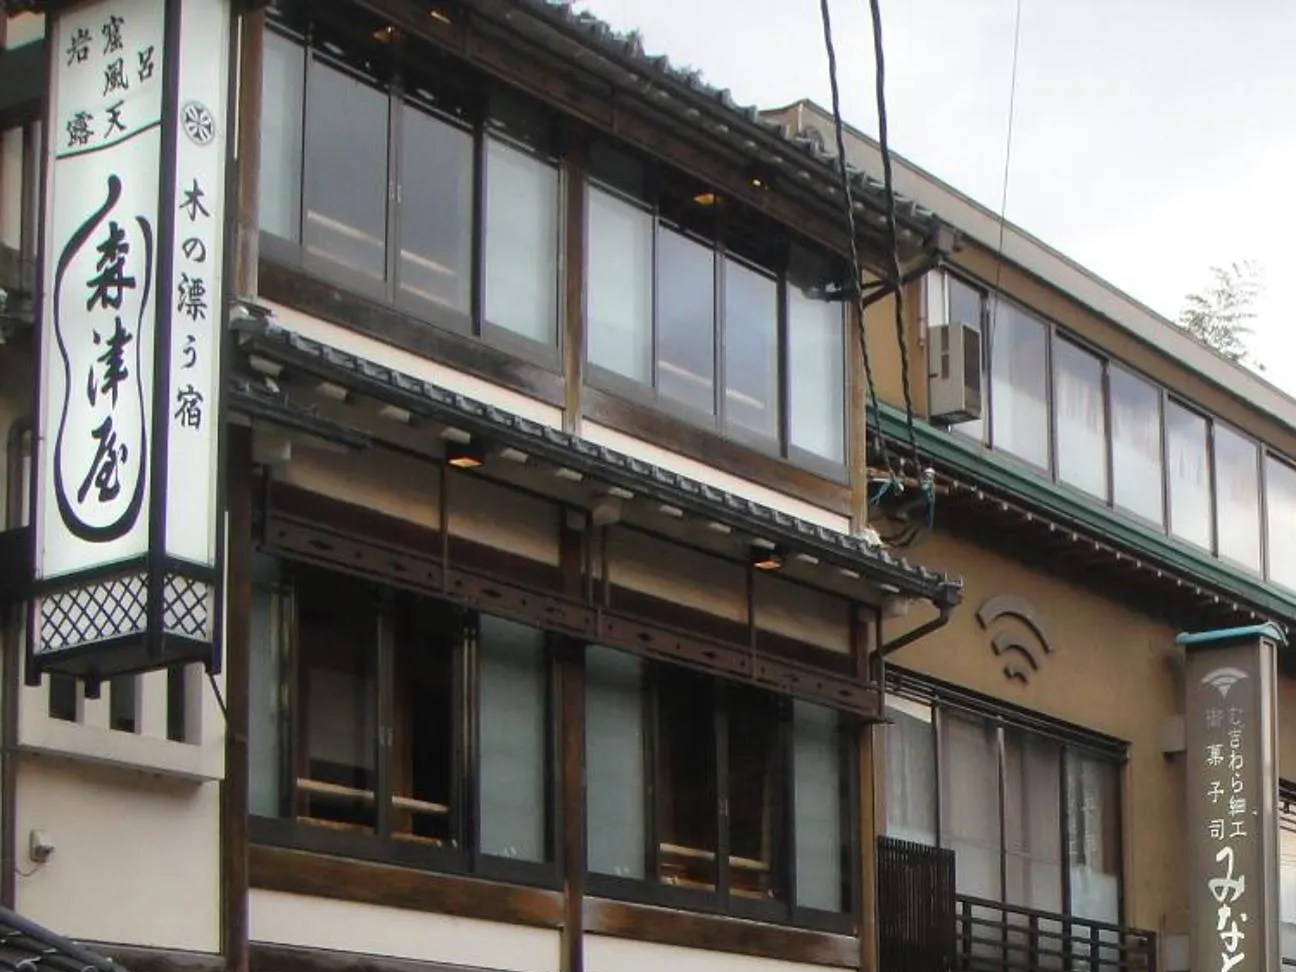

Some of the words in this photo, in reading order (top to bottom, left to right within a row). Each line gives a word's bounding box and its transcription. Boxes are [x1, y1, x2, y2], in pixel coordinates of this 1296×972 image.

[78, 221, 136, 504] 森津屋
[173, 178, 210, 430] 木の漂う宿
